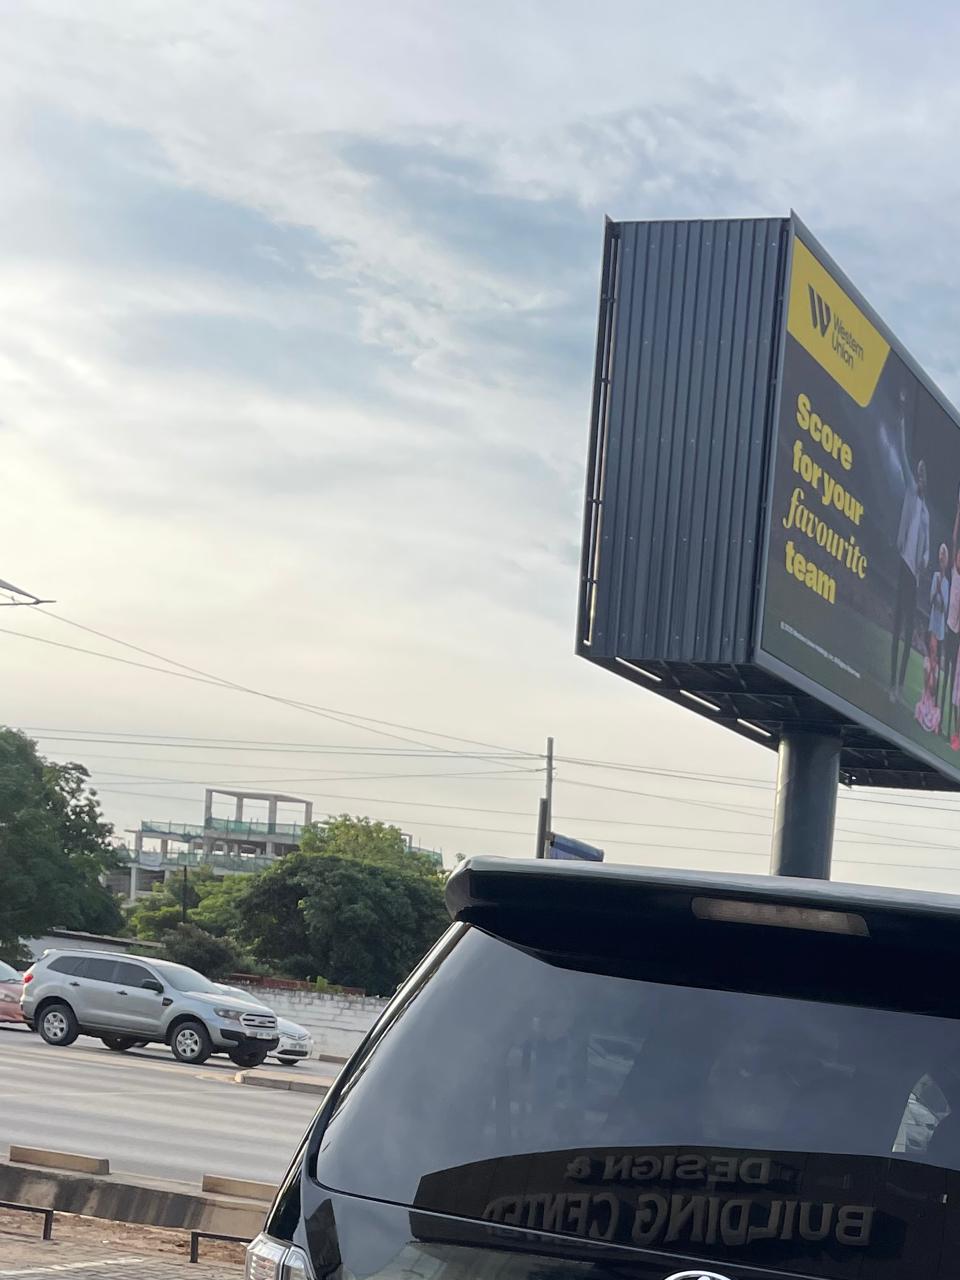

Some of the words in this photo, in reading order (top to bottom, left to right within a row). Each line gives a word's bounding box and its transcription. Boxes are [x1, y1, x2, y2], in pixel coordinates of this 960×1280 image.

[831, 332, 855, 369] Union
[833, 313, 865, 361] Western
[795, 392, 853, 471] Score
[792, 439, 823, 490] for
[821, 470, 865, 526] your
[782, 486, 868, 579] favourite
[784, 539, 837, 605] team
